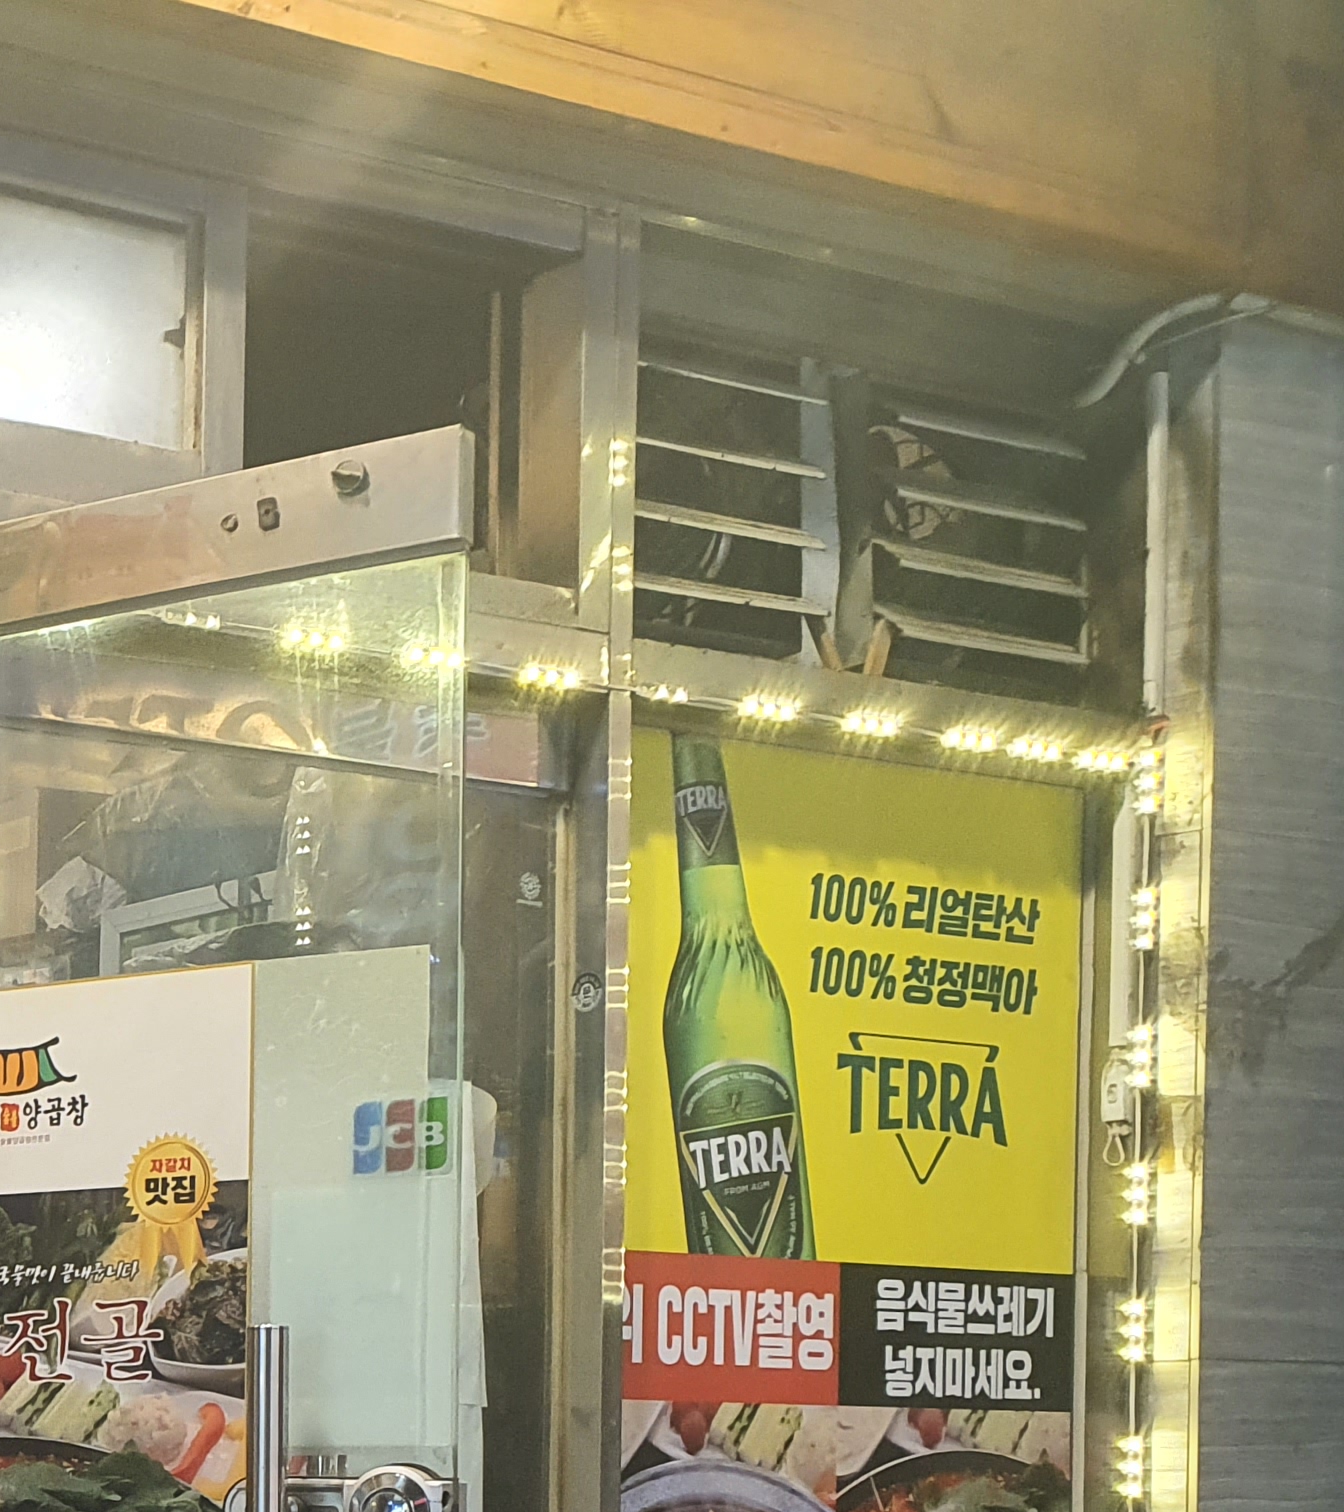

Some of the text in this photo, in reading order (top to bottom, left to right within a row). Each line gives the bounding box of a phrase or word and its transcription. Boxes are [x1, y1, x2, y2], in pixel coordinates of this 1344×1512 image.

[676, 784, 728, 817] TERRA
[810, 873, 1040, 945] 100% 리얼탄산
[809, 946, 1038, 1015] 100% 청정맥아
[23, 1094, 89, 1130] 양곱창
[837, 1044, 1008, 1148] TERRA
[149, 1155, 193, 1174] 자갈치
[353, 1115, 447, 1159] JCB
[689, 1126, 792, 1189] TERRA
[143, 1174, 197, 1207] 맛집
[875, 1278, 1055, 1338] 음식물쓰레기
[883, 1345, 1042, 1401] 넣지마세요.
